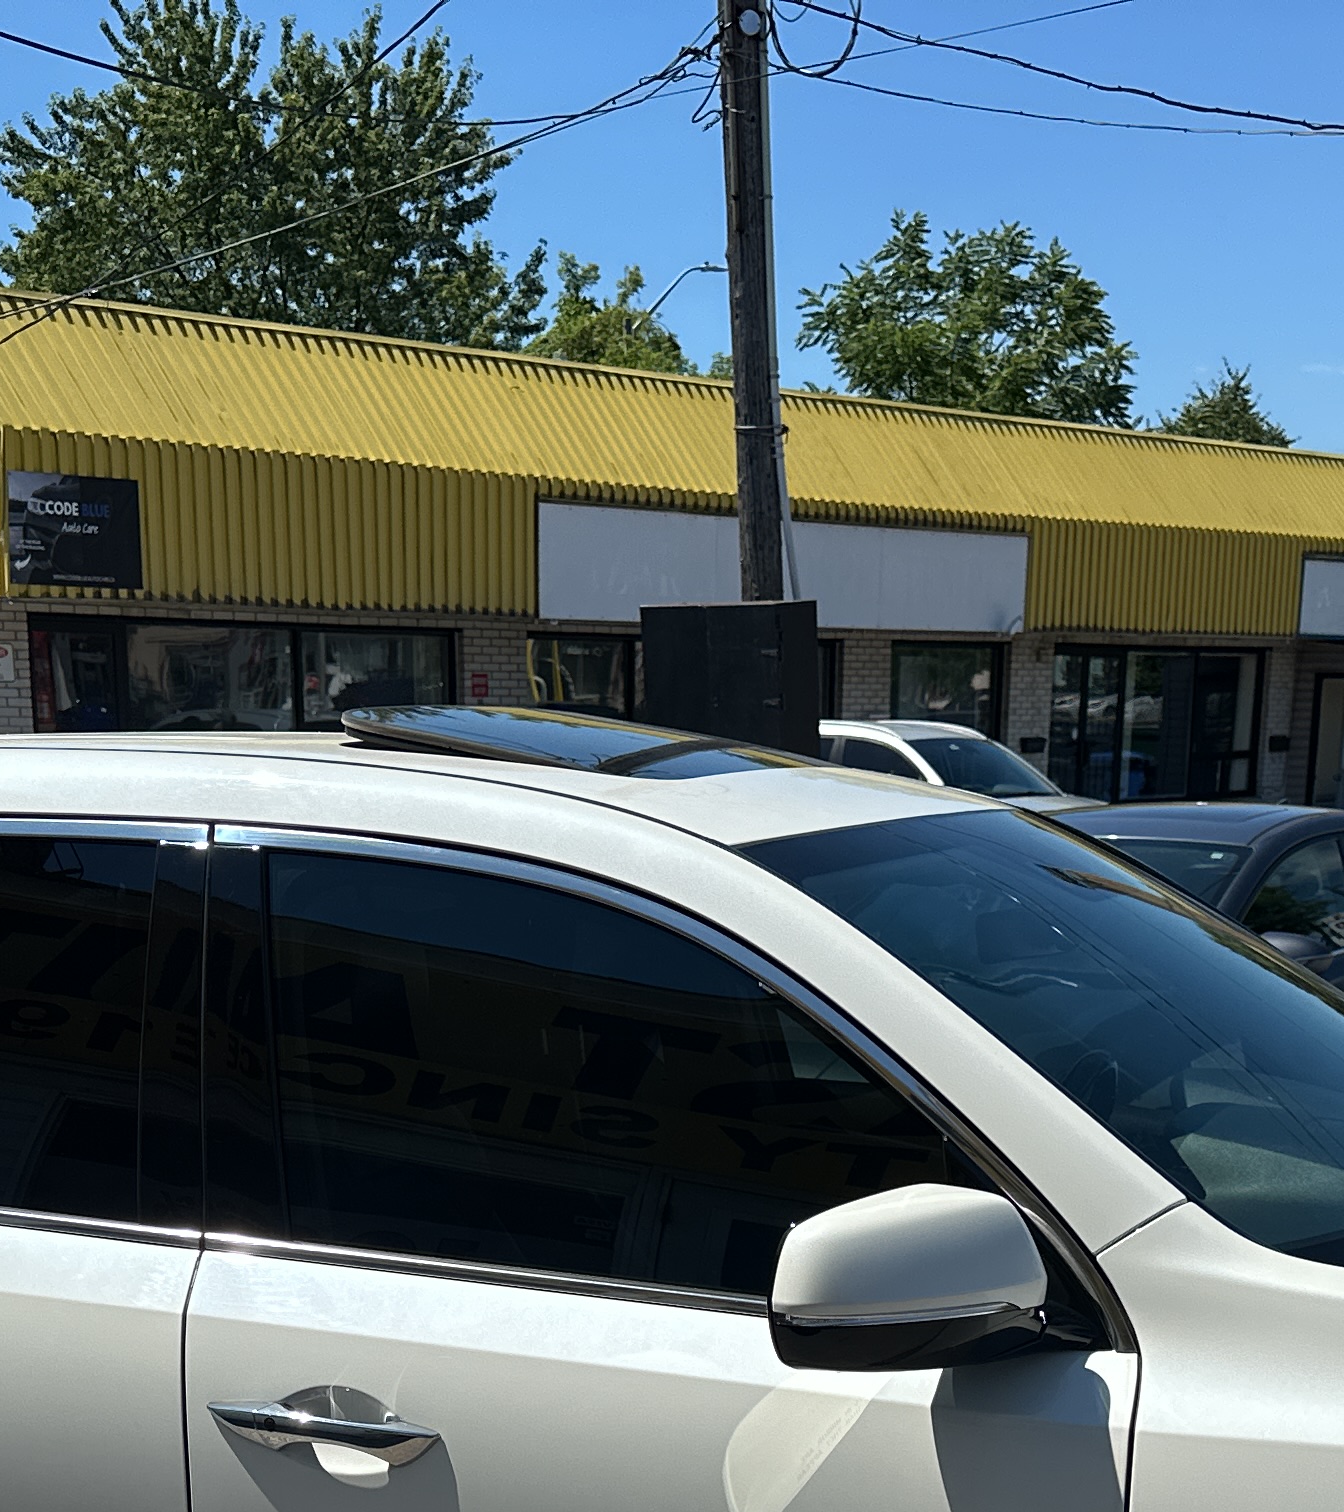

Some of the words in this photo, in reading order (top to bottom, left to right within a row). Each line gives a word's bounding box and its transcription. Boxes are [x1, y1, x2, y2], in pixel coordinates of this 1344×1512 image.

[45, 500, 79, 516] CODE
[82, 503, 110, 517] BLUE
[61, 521, 81, 534] Auto
[82, 522, 99, 535] Care
